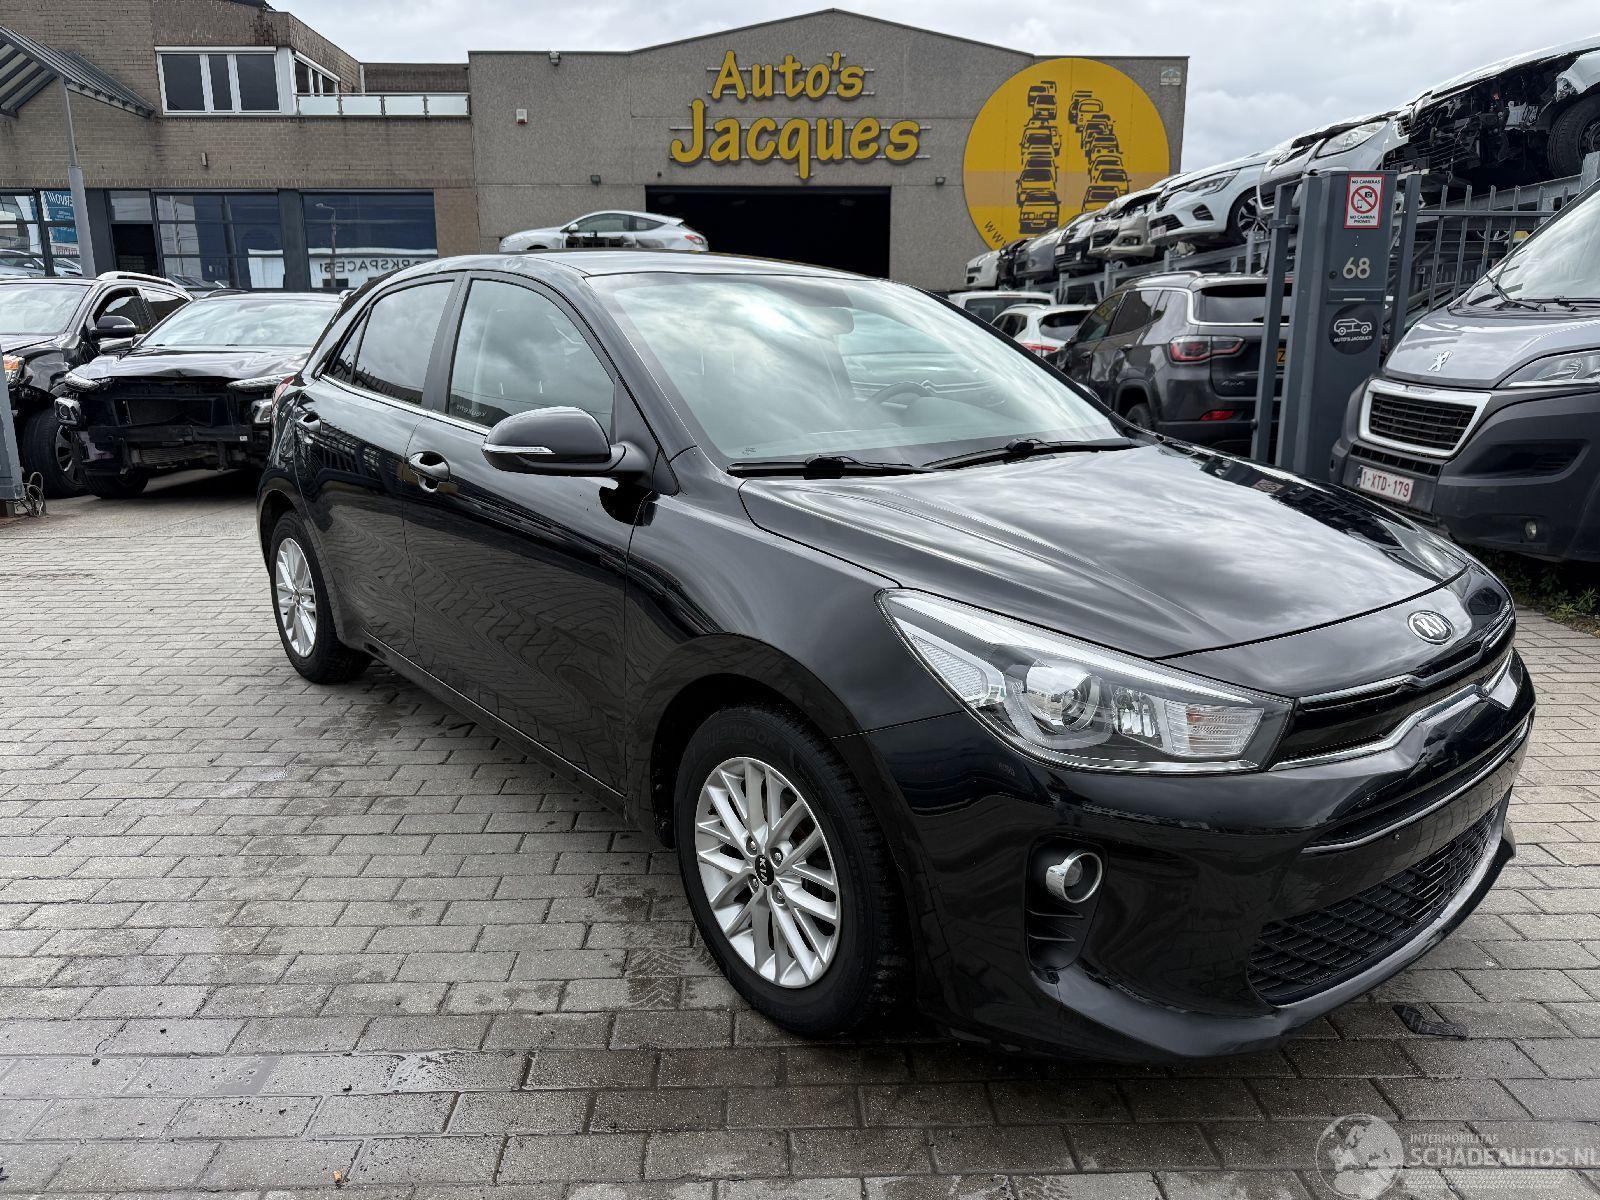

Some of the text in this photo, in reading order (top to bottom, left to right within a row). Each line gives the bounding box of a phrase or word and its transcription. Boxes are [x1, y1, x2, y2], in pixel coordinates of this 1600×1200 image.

[711, 50, 866, 100] Auto's
[670, 98, 921, 181] Jacques
[1342, 256, 1371, 279] 68
[1362, 470, 1411, 498] 1-XTD-179
